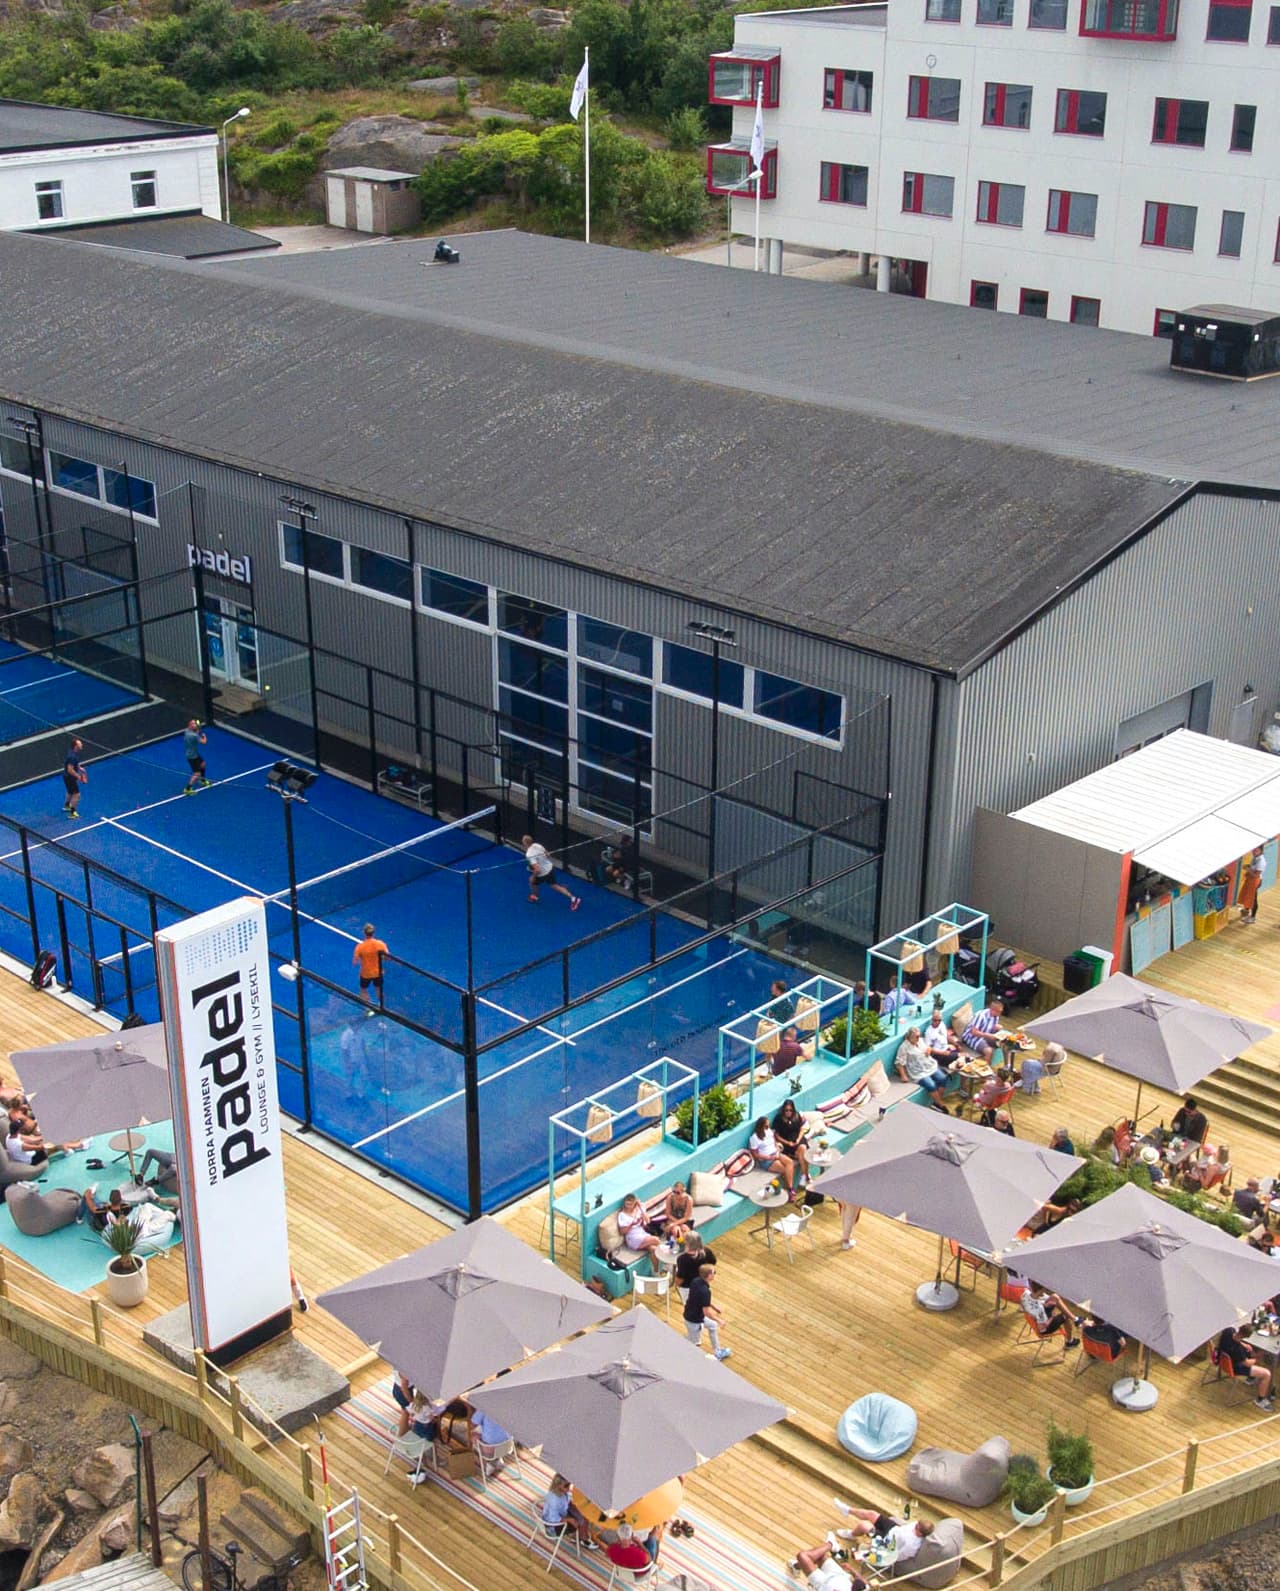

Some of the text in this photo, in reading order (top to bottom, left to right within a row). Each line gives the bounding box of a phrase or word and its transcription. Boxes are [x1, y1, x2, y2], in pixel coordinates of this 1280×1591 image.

[187, 543, 251, 584] padel
[248, 962, 261, 1020] LYSEKIL
[191, 969, 272, 1180] padel
[253, 1034, 264, 1065] GYM
[256, 1068, 265, 1079] &
[200, 1076, 218, 1186] NORRA HAMNEN
[257, 1080, 269, 1135] LOUNGE
